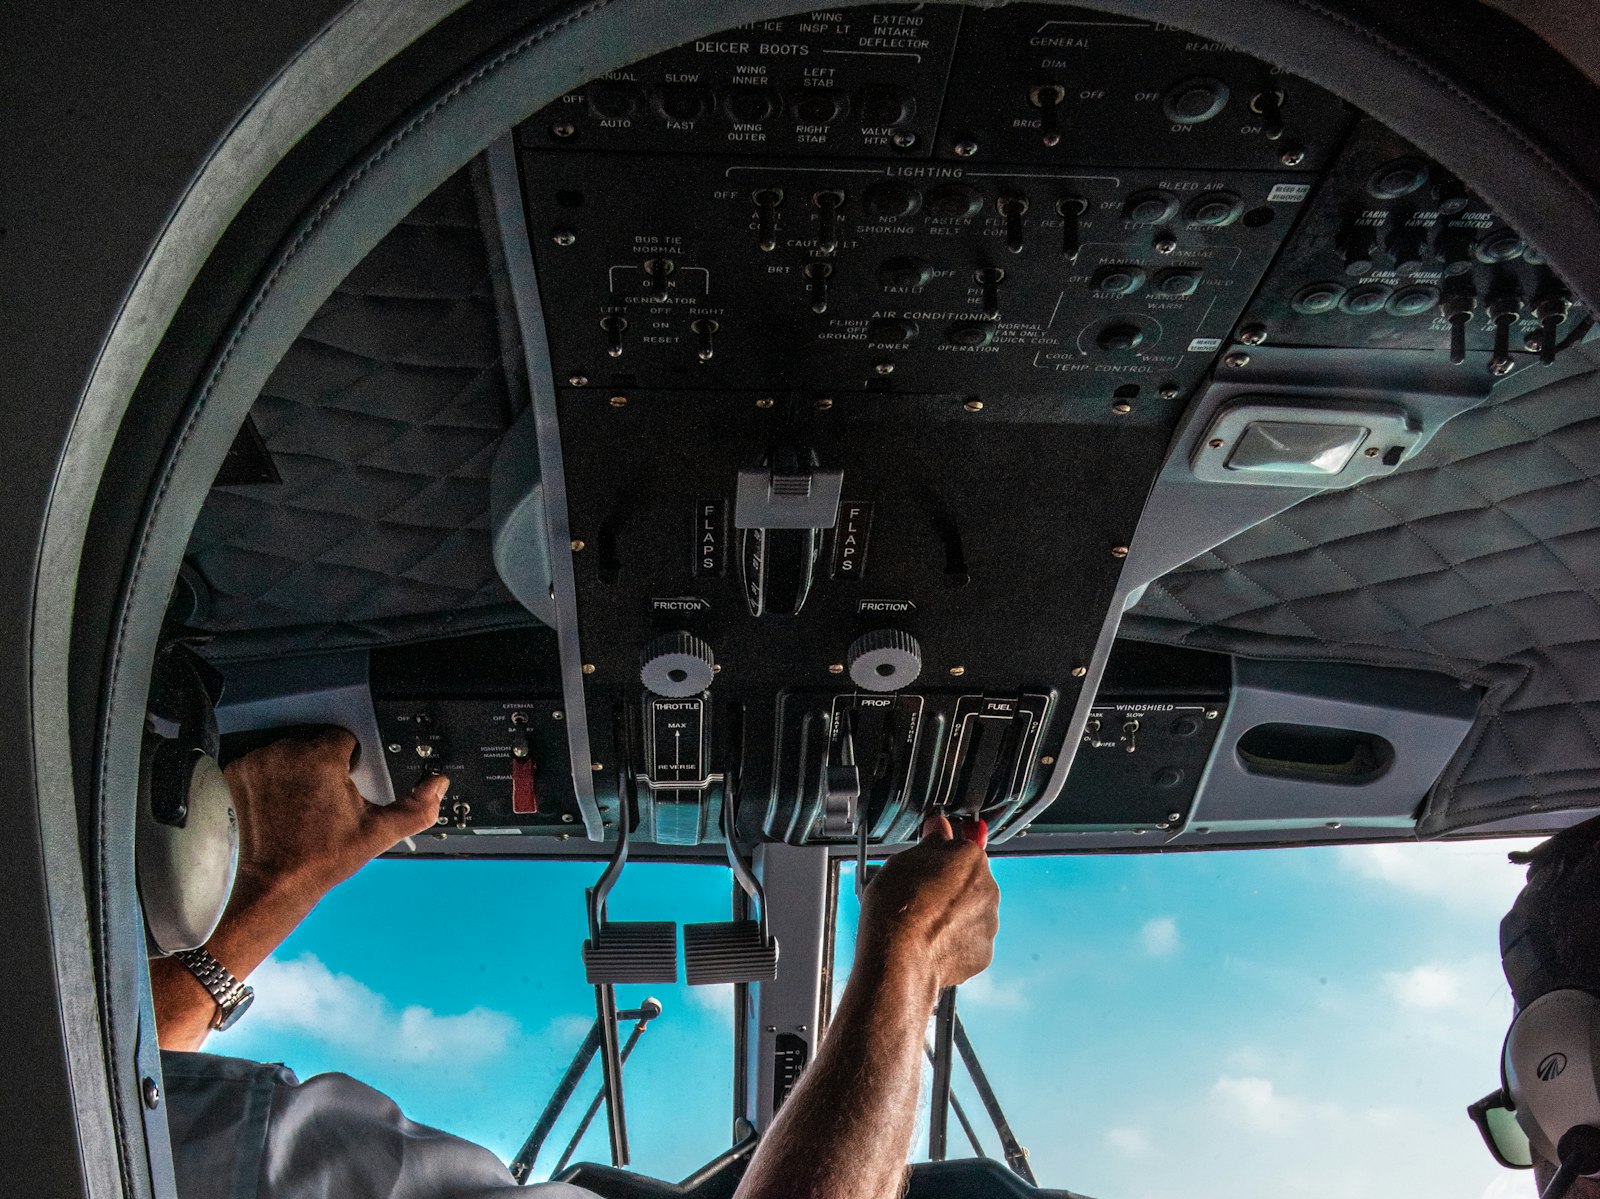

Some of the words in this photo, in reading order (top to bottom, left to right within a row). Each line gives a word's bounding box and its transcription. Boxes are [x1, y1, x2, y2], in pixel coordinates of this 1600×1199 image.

[811, 13, 843, 22] WING
[873, 15, 923, 26] EXTEND
[799, 24, 828, 33] INSP
[836, 25, 850, 34] LT
[873, 26, 918, 37] INTAKE
[859, 38, 930, 49] DEFLECTOR
[1030, 37, 1089, 50] GENERAL
[695, 42, 749, 54] DEICER
[760, 43, 809, 56] BOOTS
[1041, 59, 1067, 69] DIM
[736, 66, 766, 75] WING
[804, 68, 836, 78] LEFT
[665, 74, 699, 83] SLOW
[732, 76, 768, 86] INNER
[804, 78, 834, 87] STAB
[562, 95, 585, 104] OFF
[1079, 91, 1105, 100] OFF
[1134, 92, 1159, 102] OFF
[599, 120, 631, 128] AUTO
[666, 122, 696, 130] FAST
[732, 123, 762, 133] WING
[1171, 124, 1192, 133] ON
[796, 125, 830, 134] RIGHT
[861, 127, 894, 136] VALVE
[1241, 125, 1261, 135] ON
[727, 132, 766, 142] OUTER
[797, 134, 827, 144] STAB
[864, 137, 888, 146] HTR
[886, 167, 964, 178] LIGHTING
[1159, 182, 1205, 191] BLEED
[1208, 183, 1224, 191] AIR
[713, 191, 738, 199] OFF
[924, 217, 971, 225] FASTEN
[1448, 221, 1493, 229] UNLOCKED
[856, 225, 915, 234] SMOKING
[930, 227, 960, 235] BELT
[1124, 223, 1153, 231] LEFT
[635, 236, 659, 244] BUS
[665, 236, 682, 245] TIE
[633, 246, 685, 254] NORMAL
[934, 270, 956, 278] OFF
[1069, 276, 1092, 284] OFF
[1092, 292, 1124, 300] AUTO
[1147, 302, 1182, 310] WARM
[873, 312, 897, 320] AIR
[903, 311, 1001, 322] CONDITIONING
[847, 326, 868, 334] OFF
[817, 333, 868, 341] GROUND
[992, 336, 1027, 344] QUICK
[868, 342, 909, 350] POWER
[937, 344, 1000, 353] OPERATION
[1142, 355, 1175, 363] WARM
[1055, 364, 1088, 373] TEMP
[1094, 364, 1154, 373] CONTROL
[703, 506, 714, 568] FLAPS
[842, 509, 860, 571] FLAPS
[653, 601, 701, 610] FRICTION
[861, 602, 908, 611] FRICTION
[987, 703, 1013, 712] FUEL
